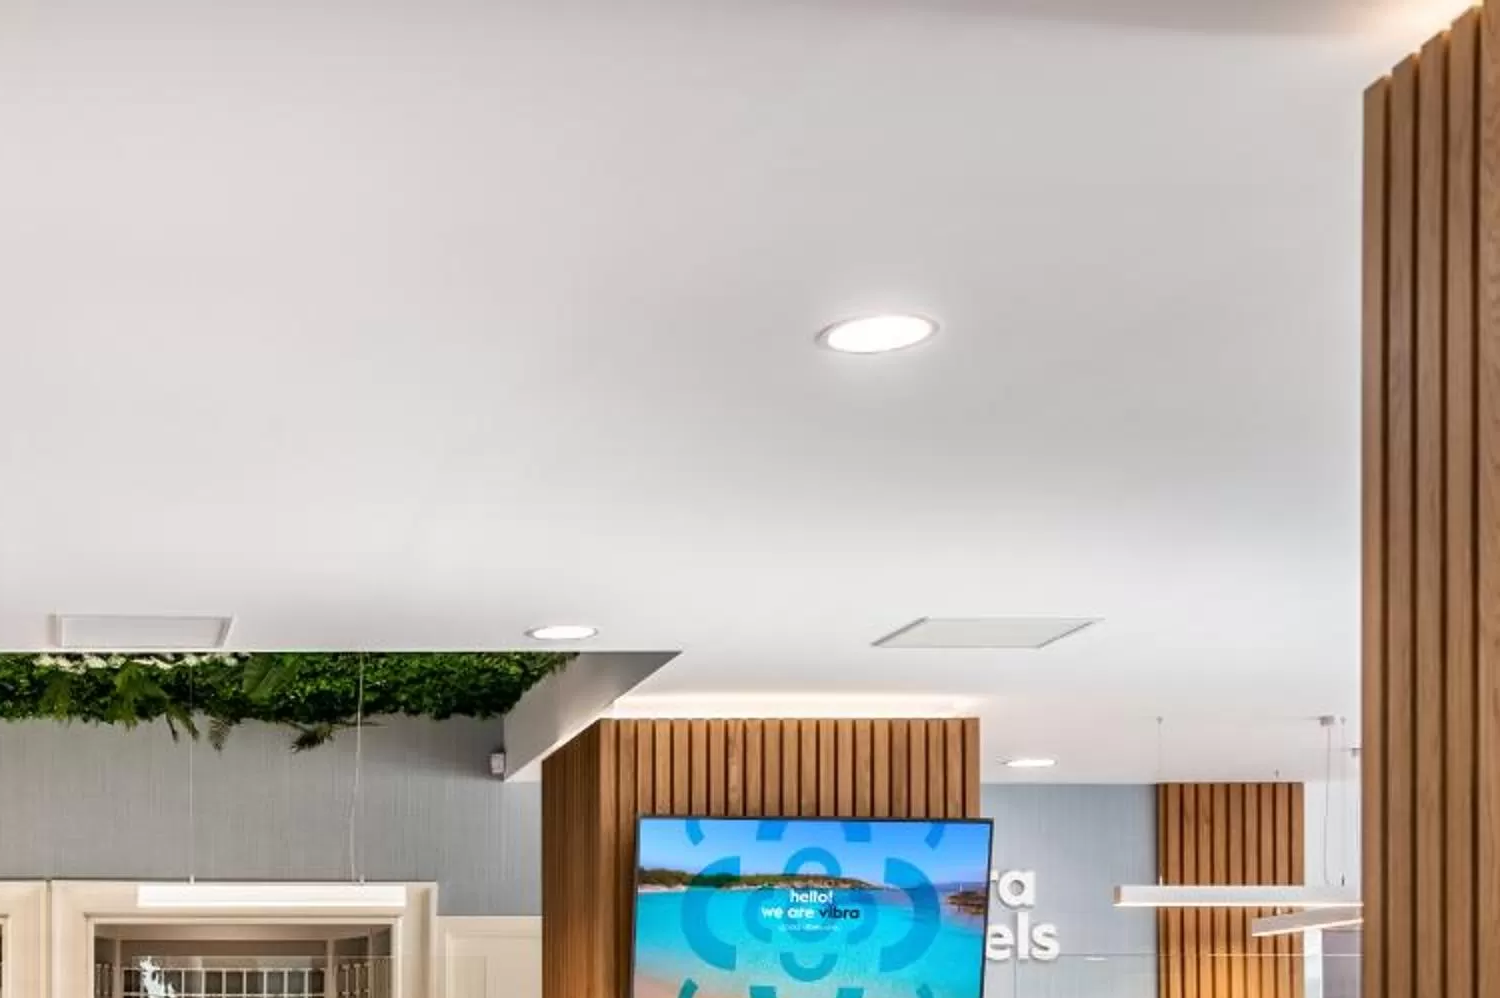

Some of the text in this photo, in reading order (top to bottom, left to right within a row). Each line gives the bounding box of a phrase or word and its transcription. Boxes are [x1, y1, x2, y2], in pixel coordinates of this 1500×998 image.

[789, 889, 834, 903] hello!
[761, 905, 861, 919] we are vibra
[986, 911, 1060, 961] els
